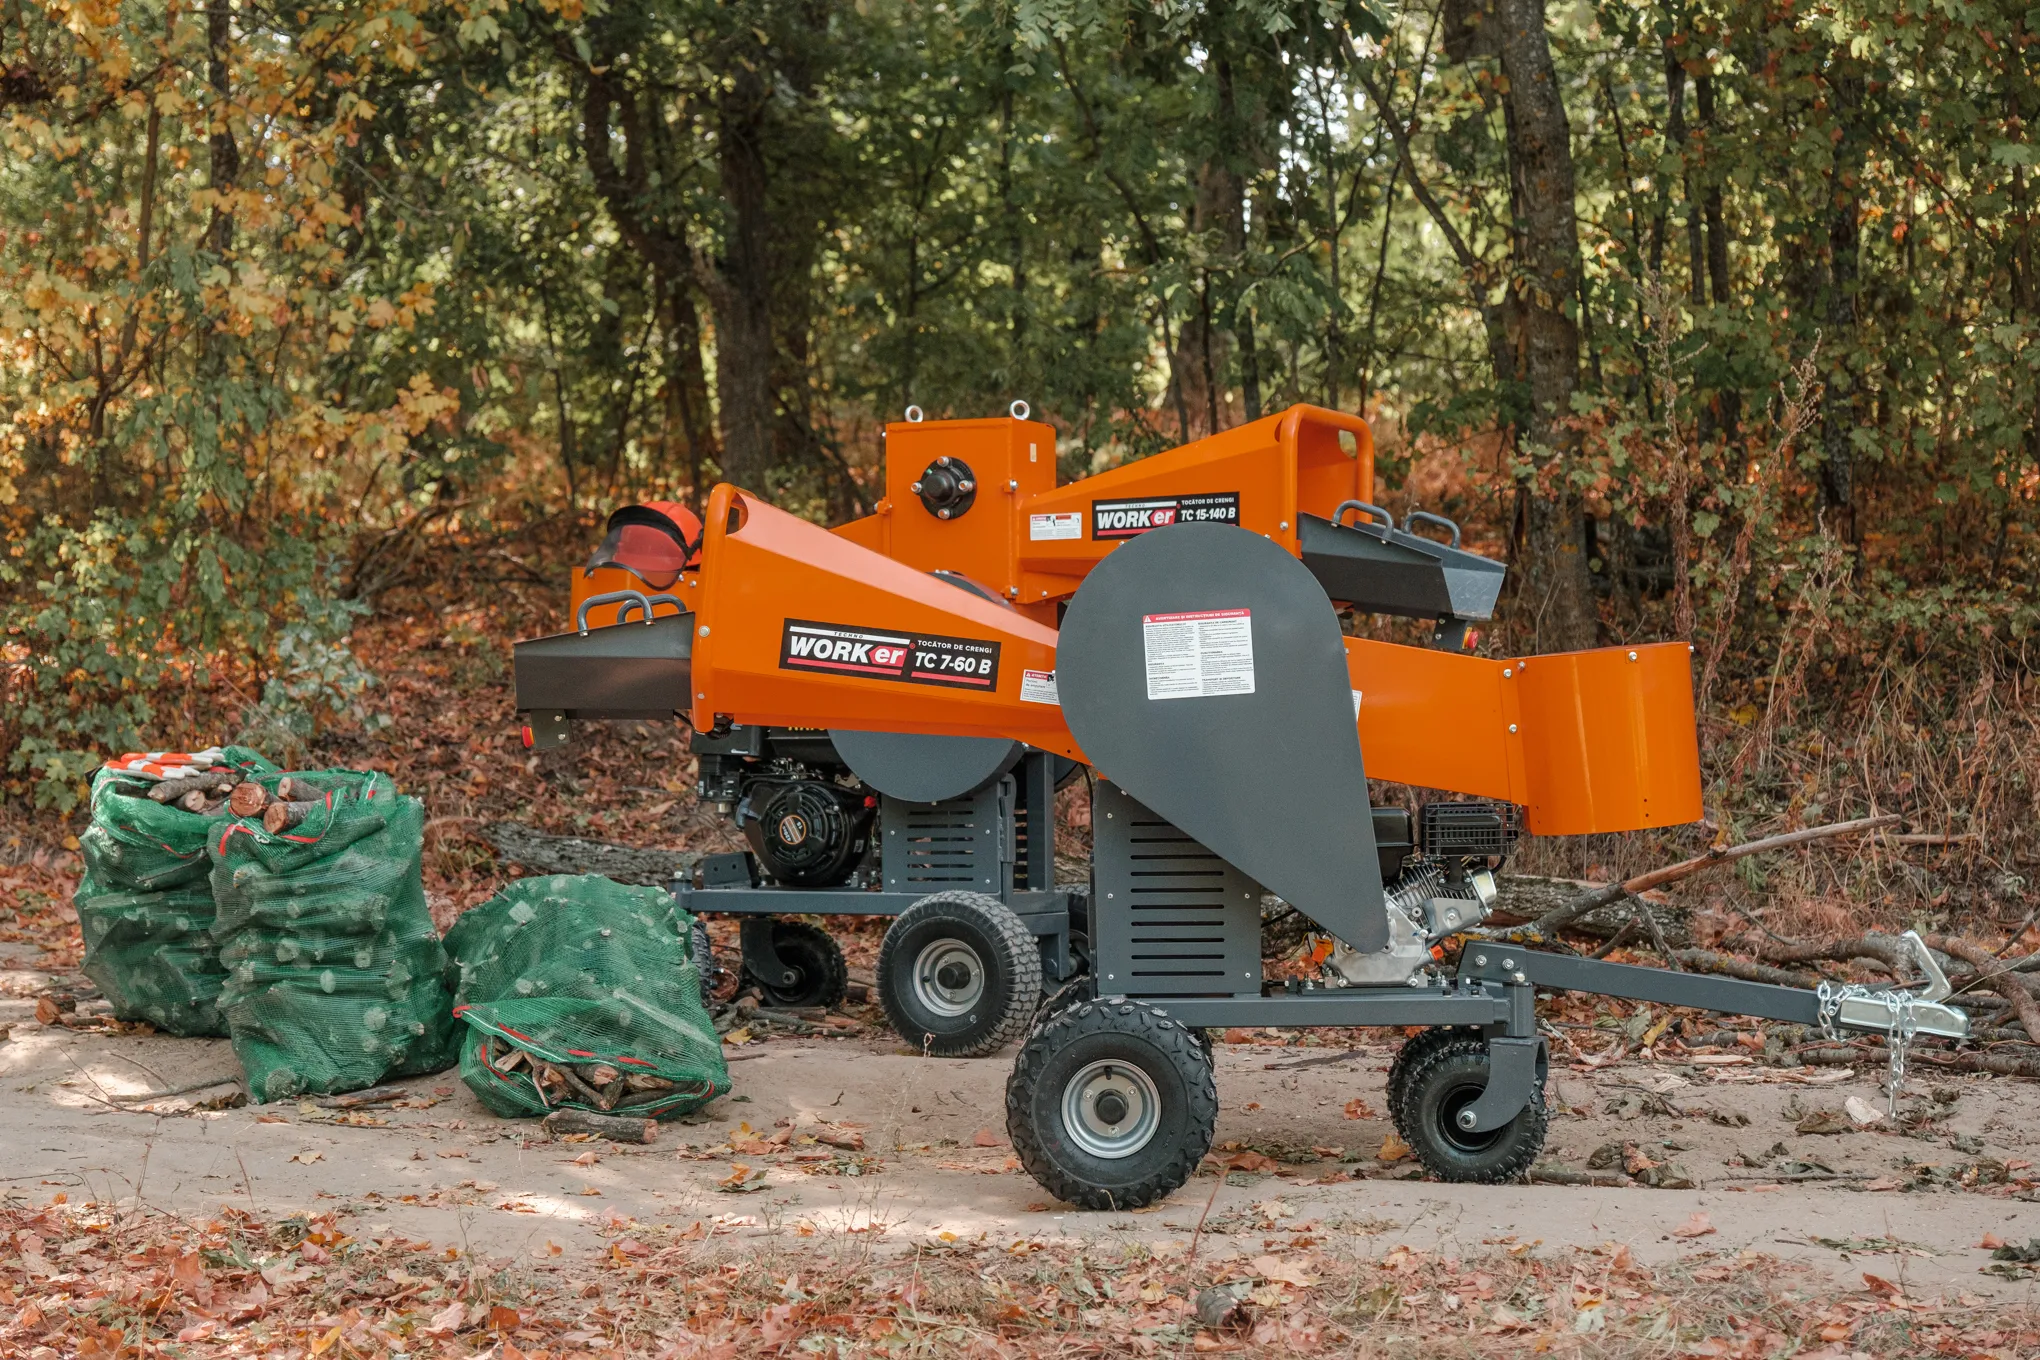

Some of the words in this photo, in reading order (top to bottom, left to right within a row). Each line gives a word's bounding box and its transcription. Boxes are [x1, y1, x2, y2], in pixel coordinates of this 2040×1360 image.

[1181, 498, 1205, 506] TOCĂTOR
[1097, 509, 1174, 529] WORKer
[1181, 508, 1194, 521] TC
[1195, 507, 1226, 520] 15-140
[1227, 506, 1236, 519] B
[834, 631, 864, 639] TECHNO
[790, 635, 905, 664] WORKer
[917, 640, 952, 649] TOCĂTOR
[965, 645, 992, 654] CRENGI
[915, 651, 938, 669] TC
[940, 654, 976, 673] 7-60
[978, 658, 992, 674] B
